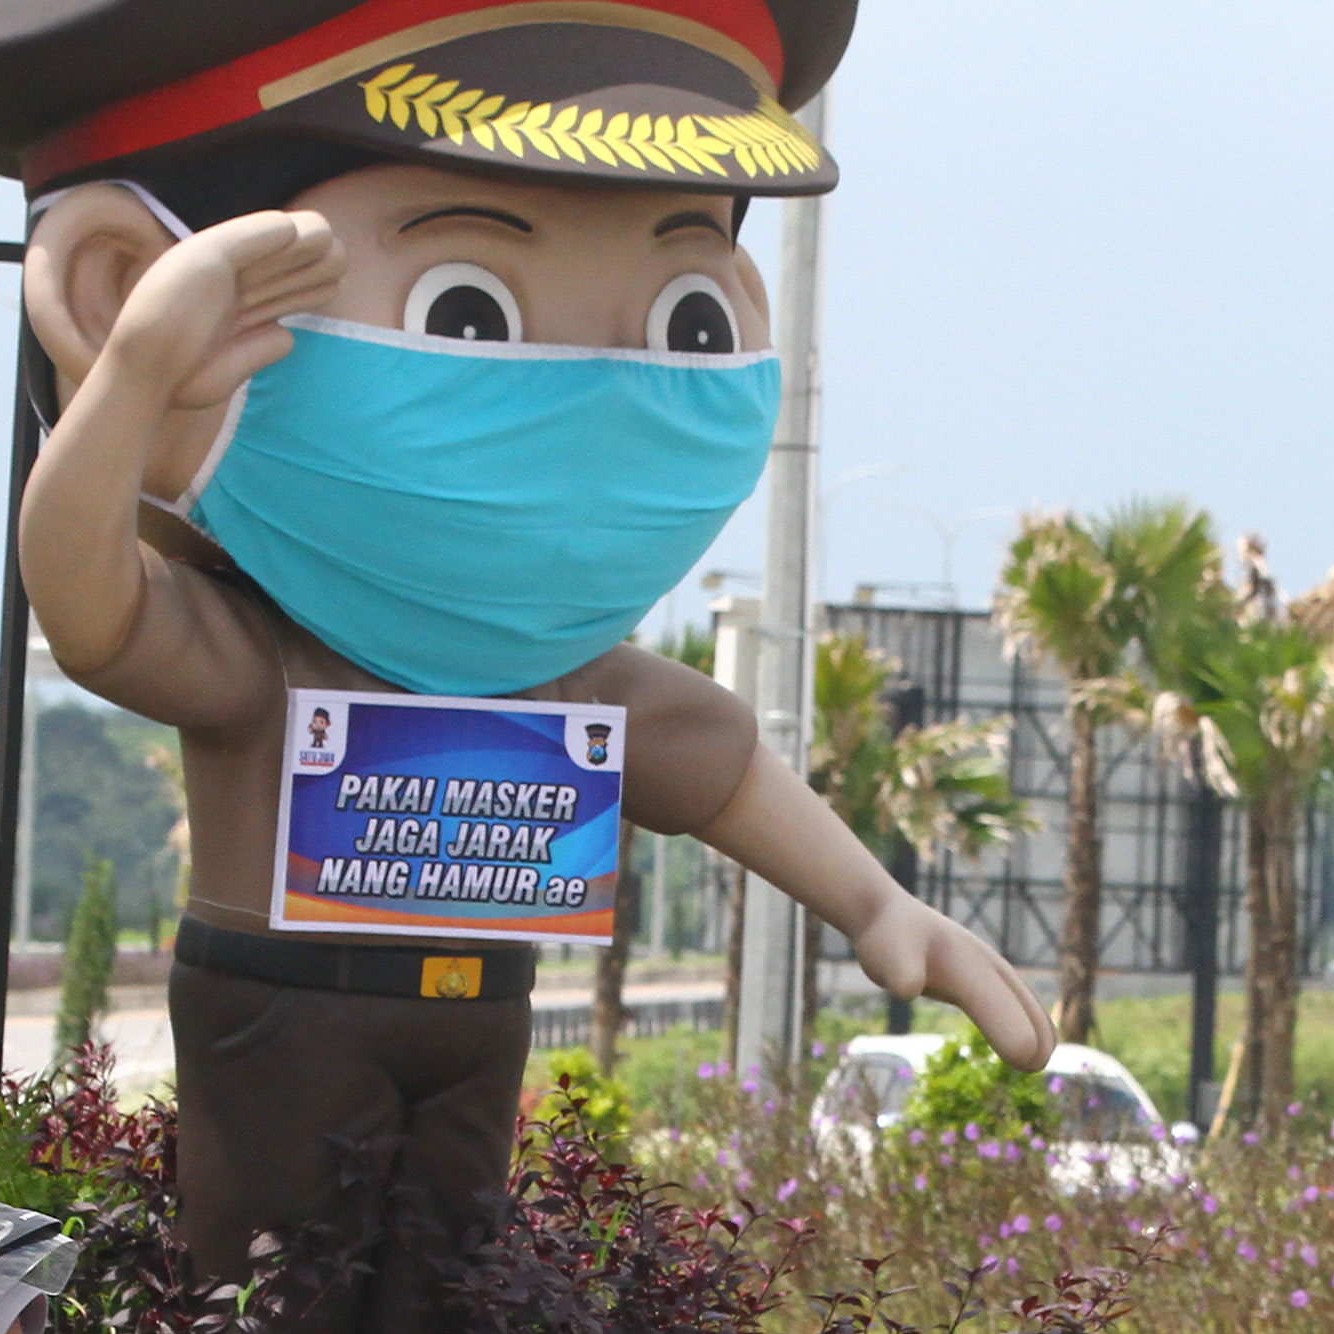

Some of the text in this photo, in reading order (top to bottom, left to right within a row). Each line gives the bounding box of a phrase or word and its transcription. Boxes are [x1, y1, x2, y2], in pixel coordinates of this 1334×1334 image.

[336, 774, 578, 822] PAKAI MASKER
[355, 818, 558, 863] JAGA JARAK
[317, 857, 587, 908] NANG HAMUR ae
